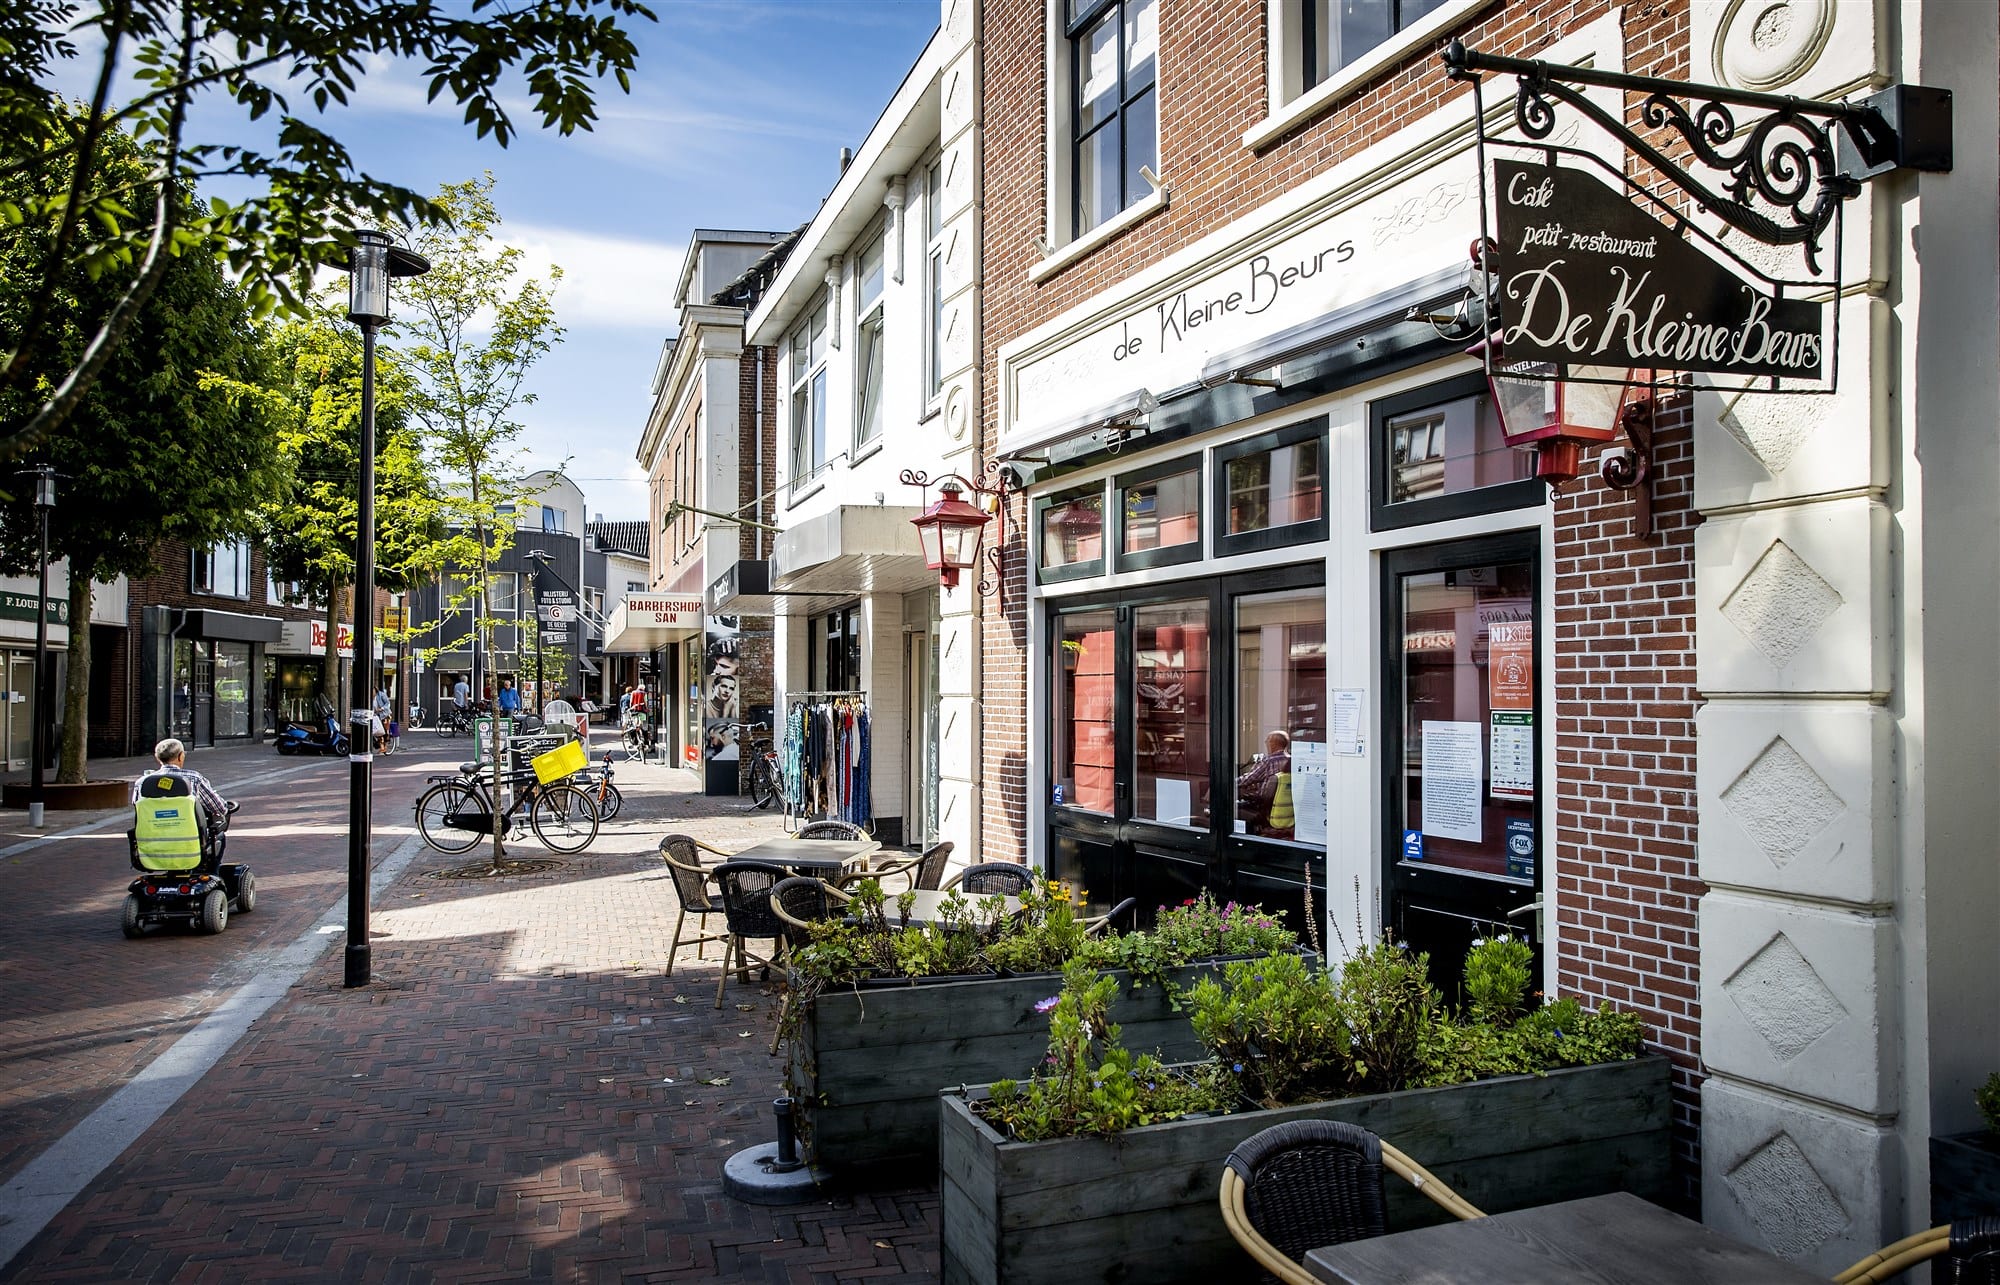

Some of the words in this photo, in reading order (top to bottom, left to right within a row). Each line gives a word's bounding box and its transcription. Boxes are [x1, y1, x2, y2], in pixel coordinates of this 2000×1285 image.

[1507, 171, 1555, 208] Café
[1516, 222, 1658, 259] petit-restaurant
[1113, 321, 1143, 361] de
[1157, 292, 1243, 354] Kleine
[1244, 239, 1355, 315] Beurs
[1503, 259, 1593, 353] De
[1590, 265, 1729, 361] Kleine
[1727, 284, 1822, 369] Beurs
[1502, 361, 1531, 373] AMSTEL
[629, 600, 702, 613] BARBERSHOP
[655, 612, 677, 623] SAN
[1515, 839, 1529, 848] FOX
